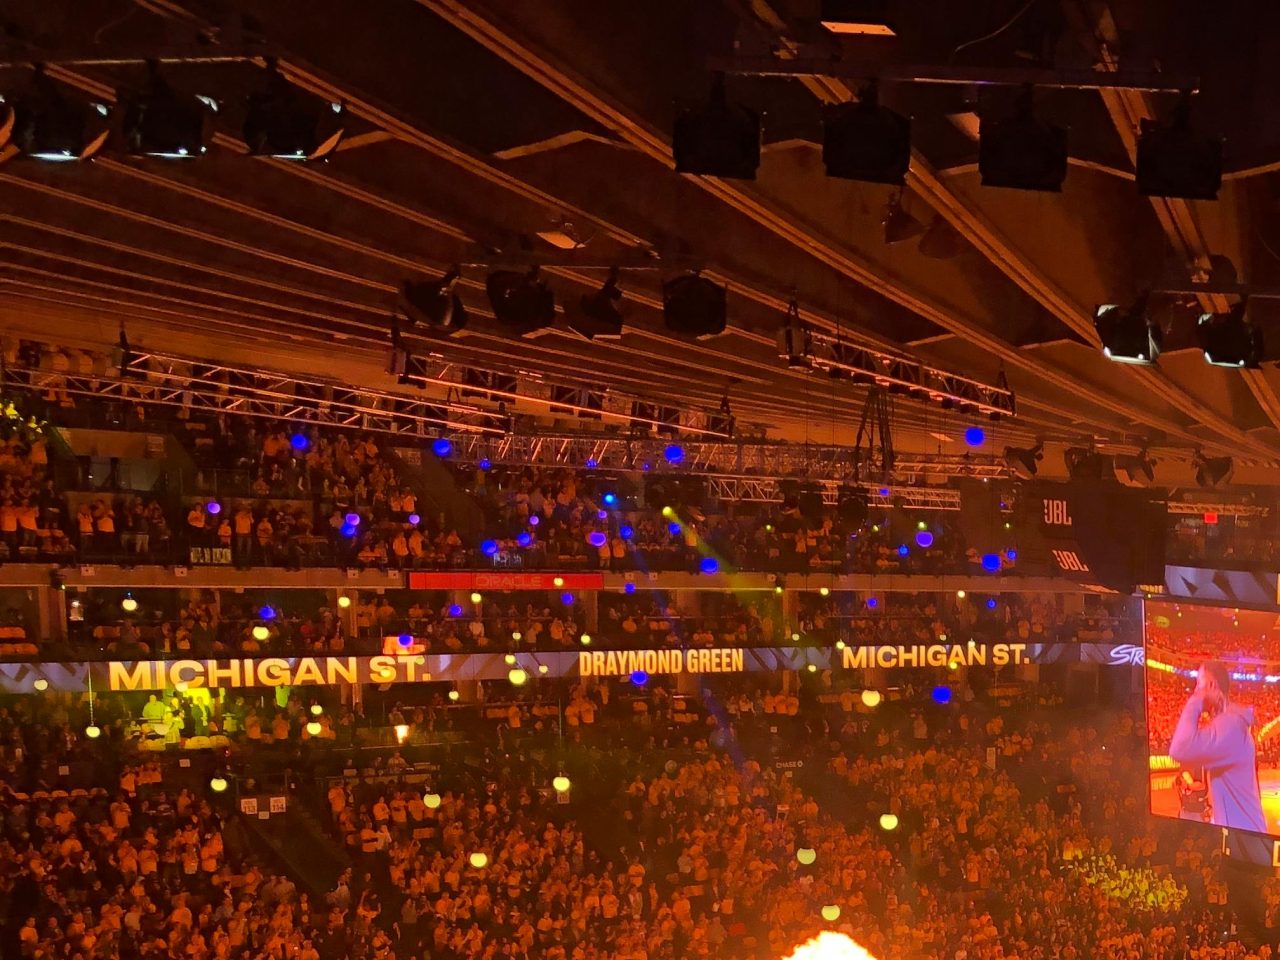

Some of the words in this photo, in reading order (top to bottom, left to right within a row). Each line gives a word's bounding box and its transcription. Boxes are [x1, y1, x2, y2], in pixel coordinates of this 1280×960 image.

[475, 576, 542, 588] ORACLE
[579, 650, 683, 676] DRAYMOND
[686, 648, 743, 673] GREEN
[843, 643, 986, 669] MICHIGAN
[992, 643, 1030, 665] ST.
[109, 657, 358, 690] MICHIGAN
[369, 655, 431, 684] ST.
